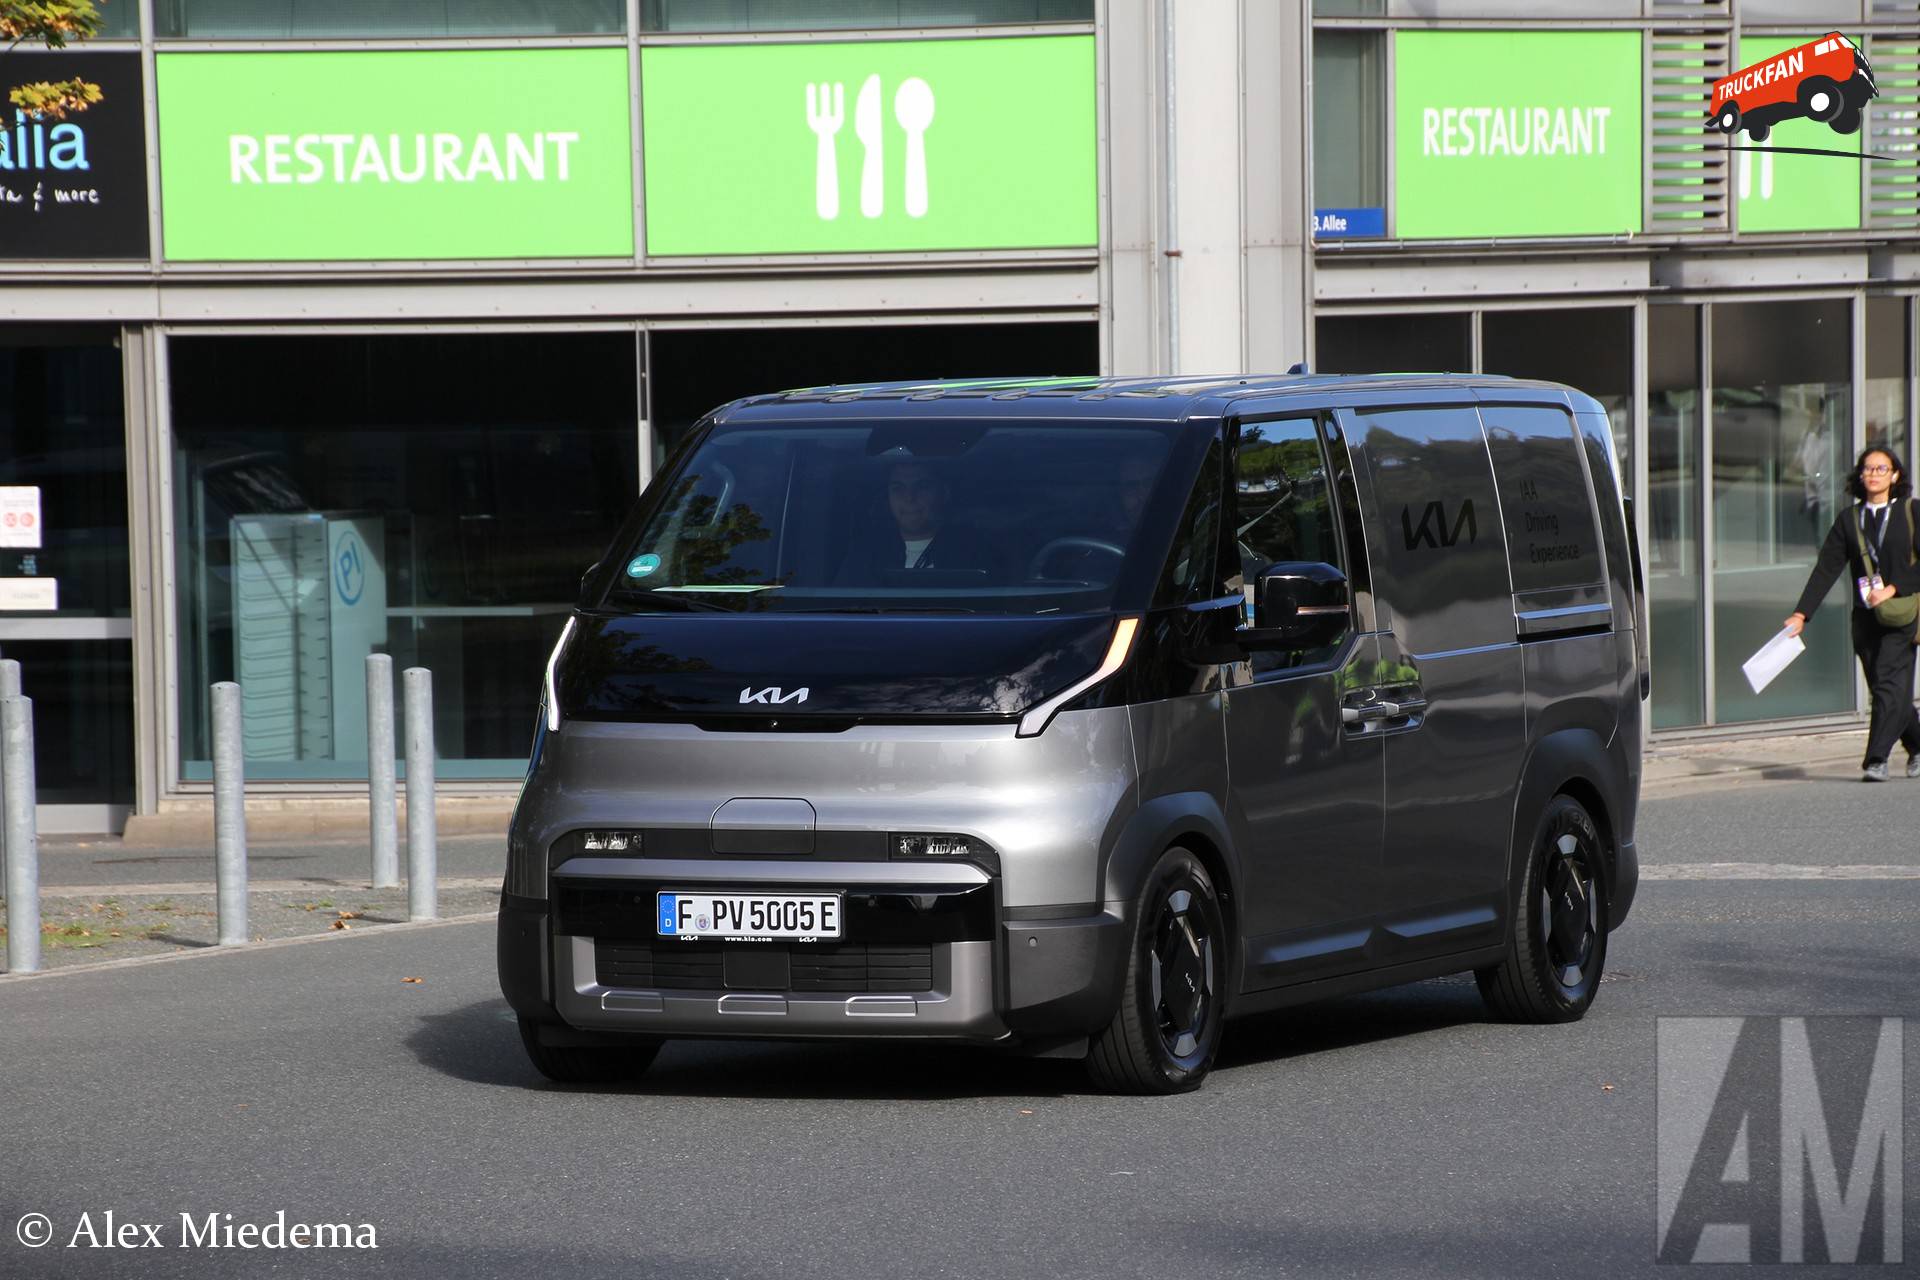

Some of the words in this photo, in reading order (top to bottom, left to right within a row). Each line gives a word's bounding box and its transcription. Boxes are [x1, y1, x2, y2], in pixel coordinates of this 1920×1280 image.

[1422, 106, 1611, 157] RESTAURANT
[228, 131, 580, 184] RESTAURANT
[54, 188, 100, 204] more
[1322, 214, 1348, 232] Allee
[1401, 498, 1478, 551] KIA
[1524, 510, 1559, 537] Driving
[1529, 542, 1581, 569] Experience
[738, 686, 810, 705] KIA
[724, 935, 773, 943] www.kia.com
